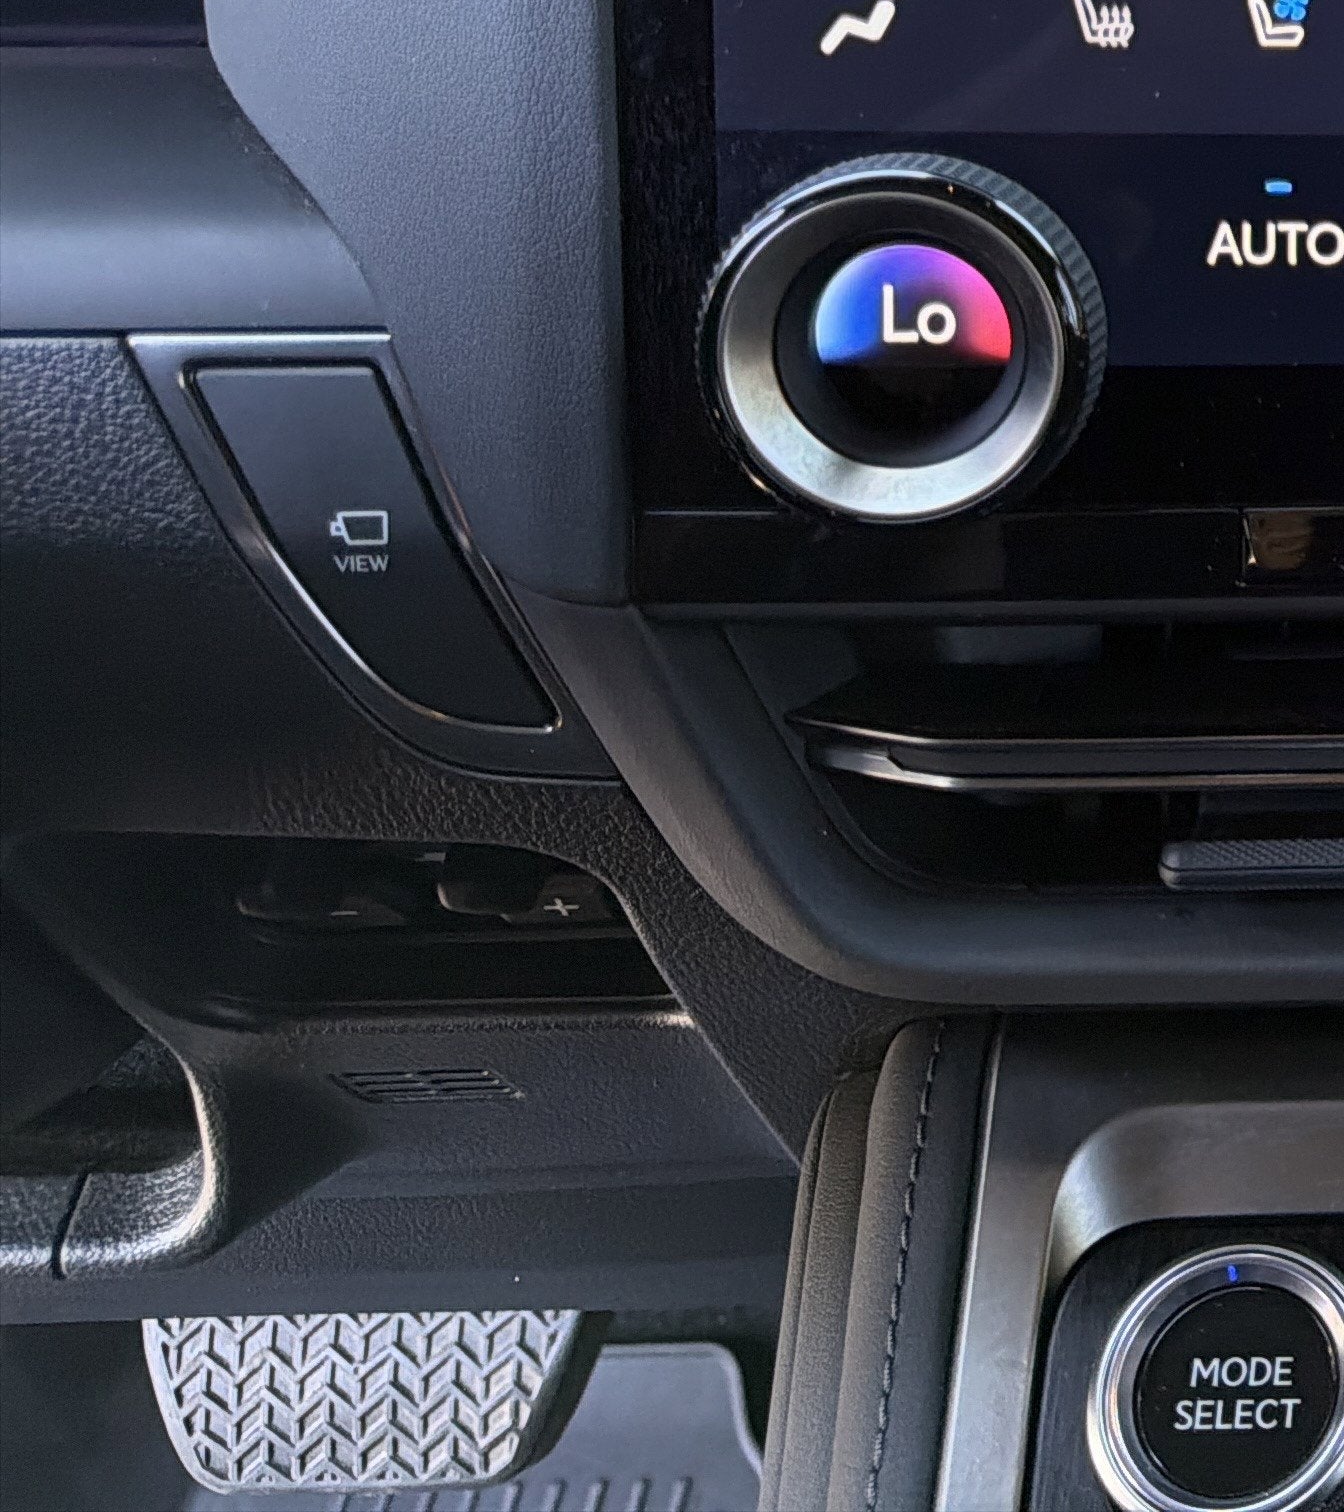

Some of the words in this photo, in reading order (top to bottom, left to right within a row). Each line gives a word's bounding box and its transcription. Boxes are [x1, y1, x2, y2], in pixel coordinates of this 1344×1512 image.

[882, 283, 957, 345] Lo
[333, 554, 389, 573] VIEW
[1189, 1356, 1294, 1388] MODE
[1174, 1398, 1301, 1431] SELECT
